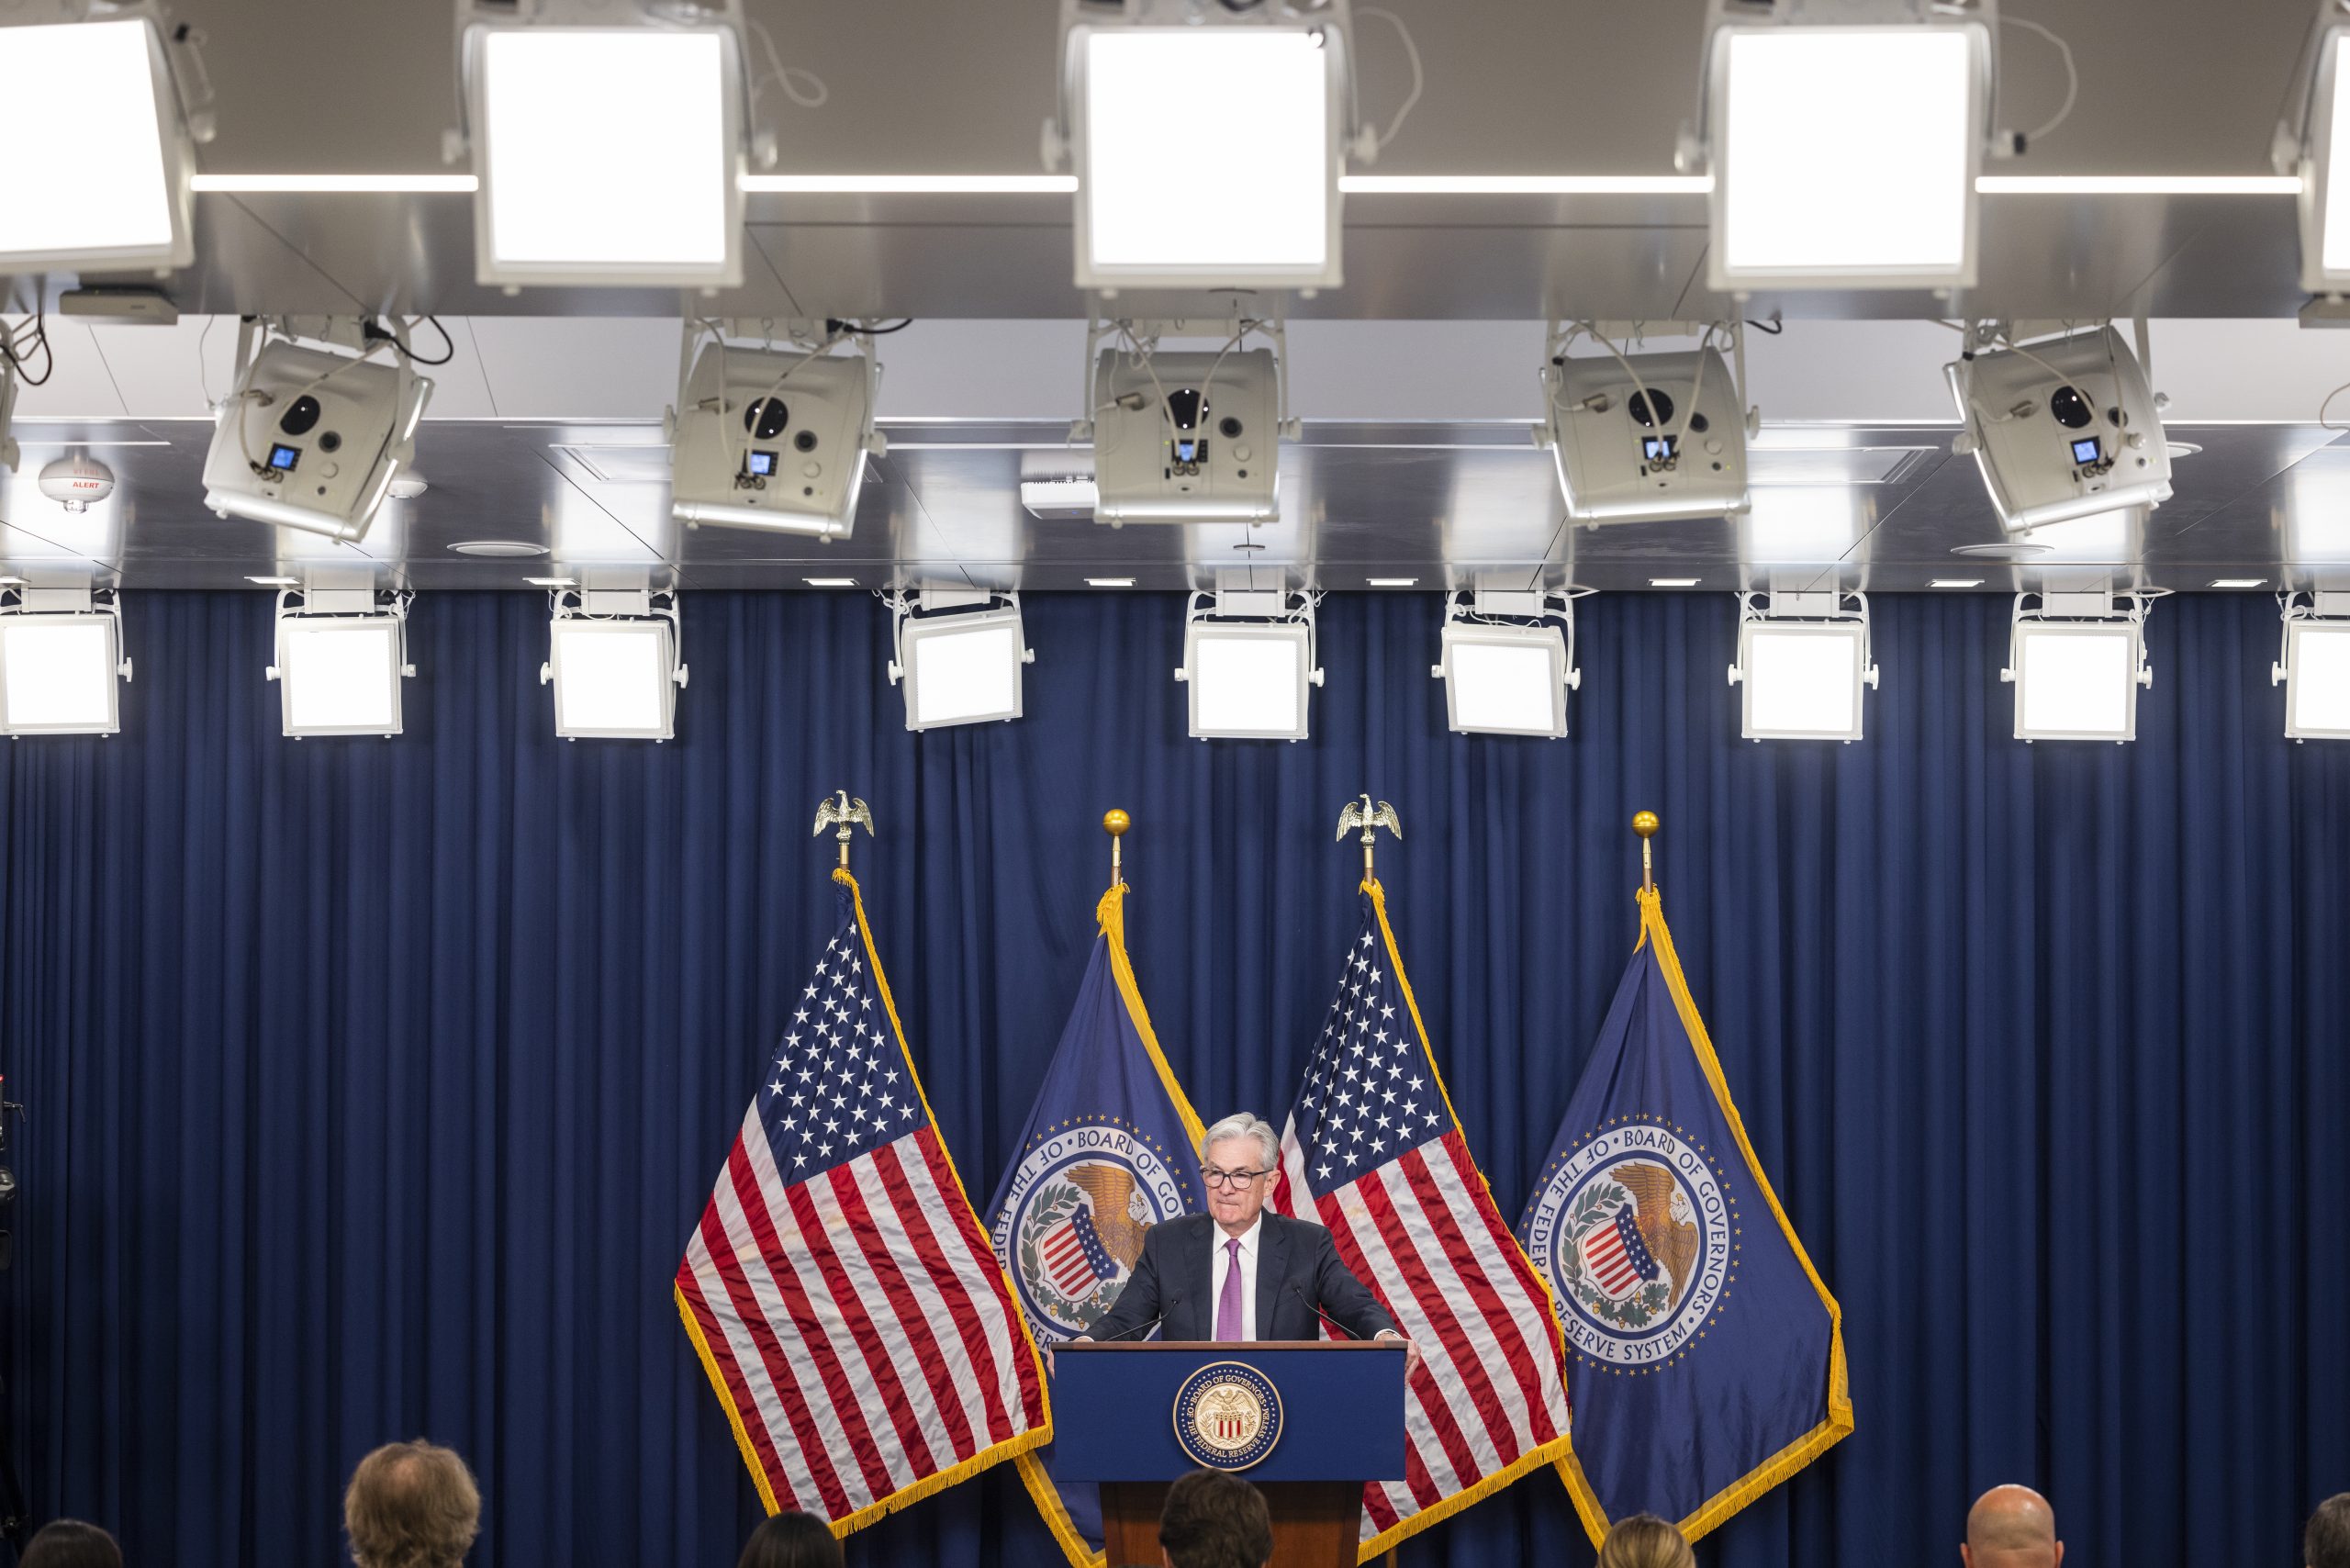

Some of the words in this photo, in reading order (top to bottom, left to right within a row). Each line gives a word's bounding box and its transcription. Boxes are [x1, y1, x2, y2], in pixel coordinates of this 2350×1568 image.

[1040, 1141, 1063, 1167] OF
[1078, 1130, 1134, 1155] BOARD
[1136, 1153, 1160, 1177] OF
[1587, 1140, 1609, 1166] OF
[1011, 1165, 1037, 1202] THE
[1550, 1161, 1583, 1198] THE
[1624, 1130, 1675, 1155] BOARD
[1679, 1152, 1703, 1177] OF
[1692, 1181, 1727, 1316] GOVERNORS
[1624, 1321, 1688, 1361] SYSTEM
[1191, 1380, 1213, 1404] BOARD
[1213, 1375, 1224, 1383] OF
[1225, 1374, 1266, 1405] GOVERNORS
[1187, 1406, 1194, 1419] OF
[1187, 1419, 1198, 1437] THE
[1258, 1407, 1270, 1439] SYSTEM
[1194, 1437, 1227, 1458] FEDERAL
[1228, 1438, 1261, 1458] RESERVE
